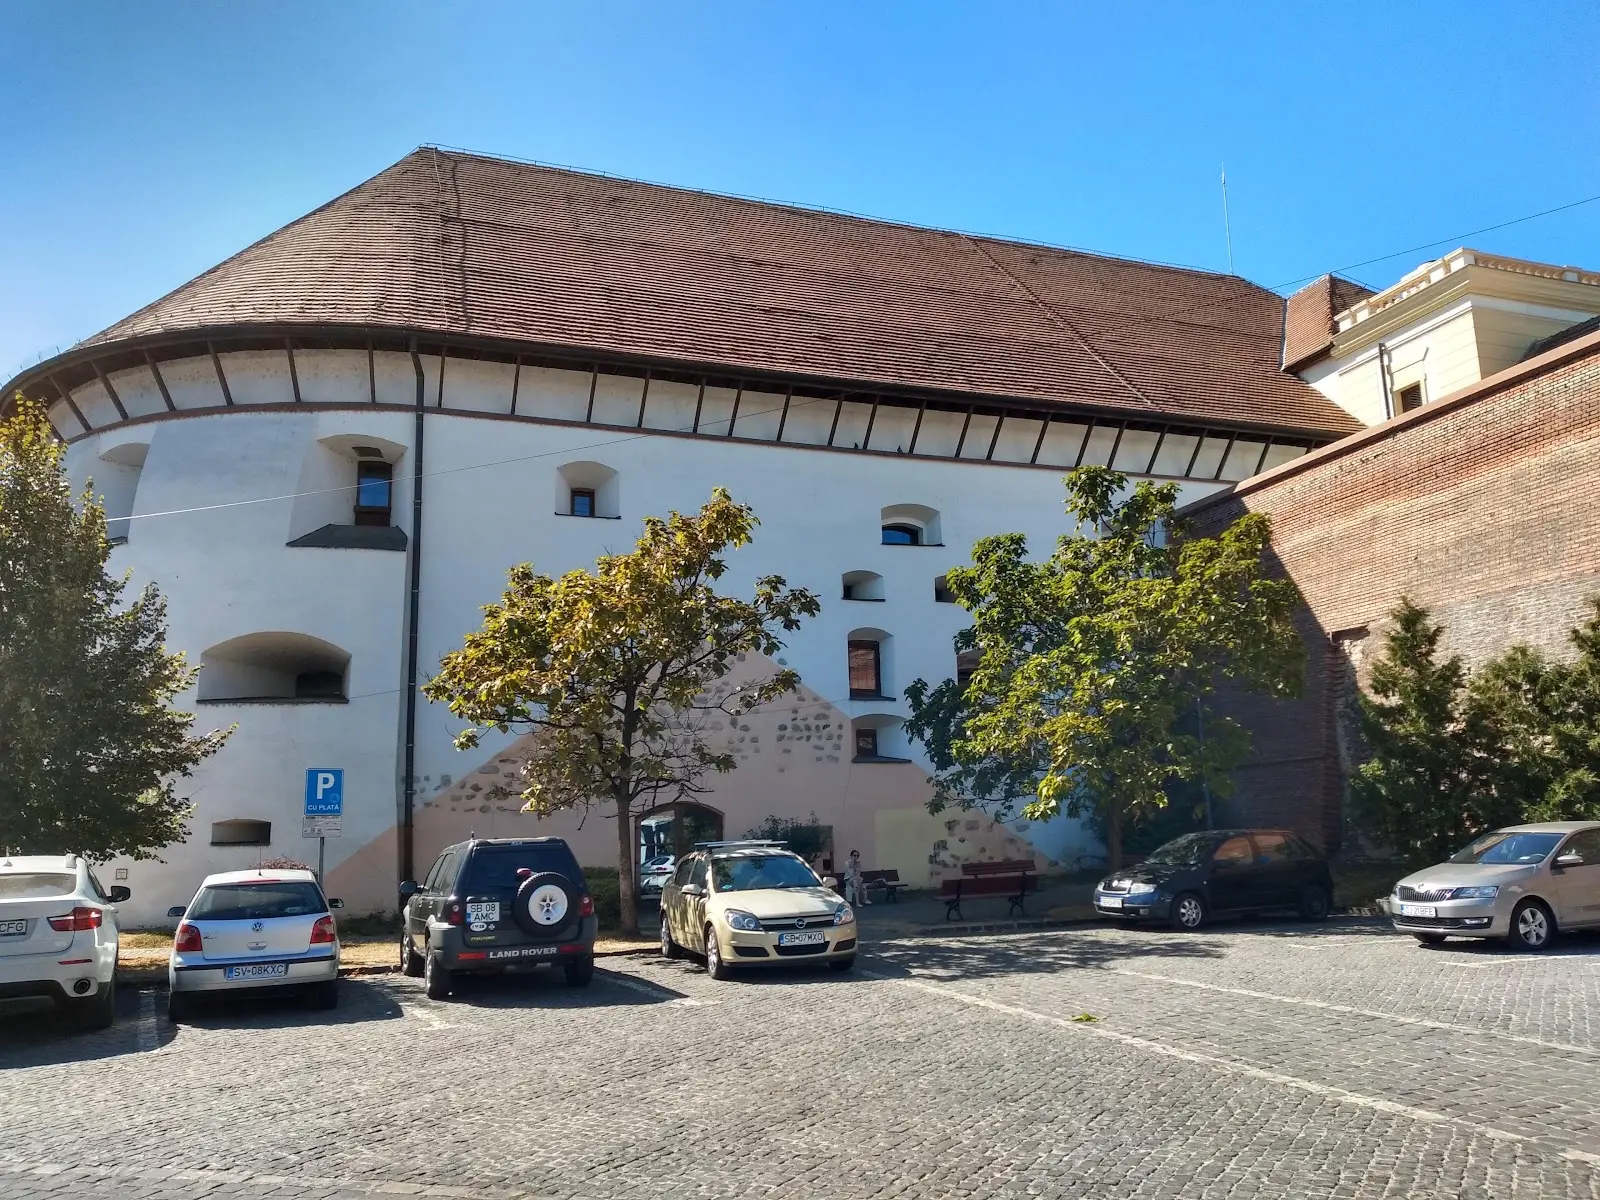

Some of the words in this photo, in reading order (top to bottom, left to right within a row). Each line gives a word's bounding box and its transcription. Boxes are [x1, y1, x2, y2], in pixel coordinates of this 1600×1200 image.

[316, 772, 335, 800] P
[318, 803, 340, 811] PLATĂ
[470, 904, 483, 913] SB
[485, 903, 496, 912] 08
[473, 912, 494, 922] AMC
[0, 922, 24, 933] CFG
[489, 950, 519, 959] LAND
[521, 947, 557, 956] ROVER
